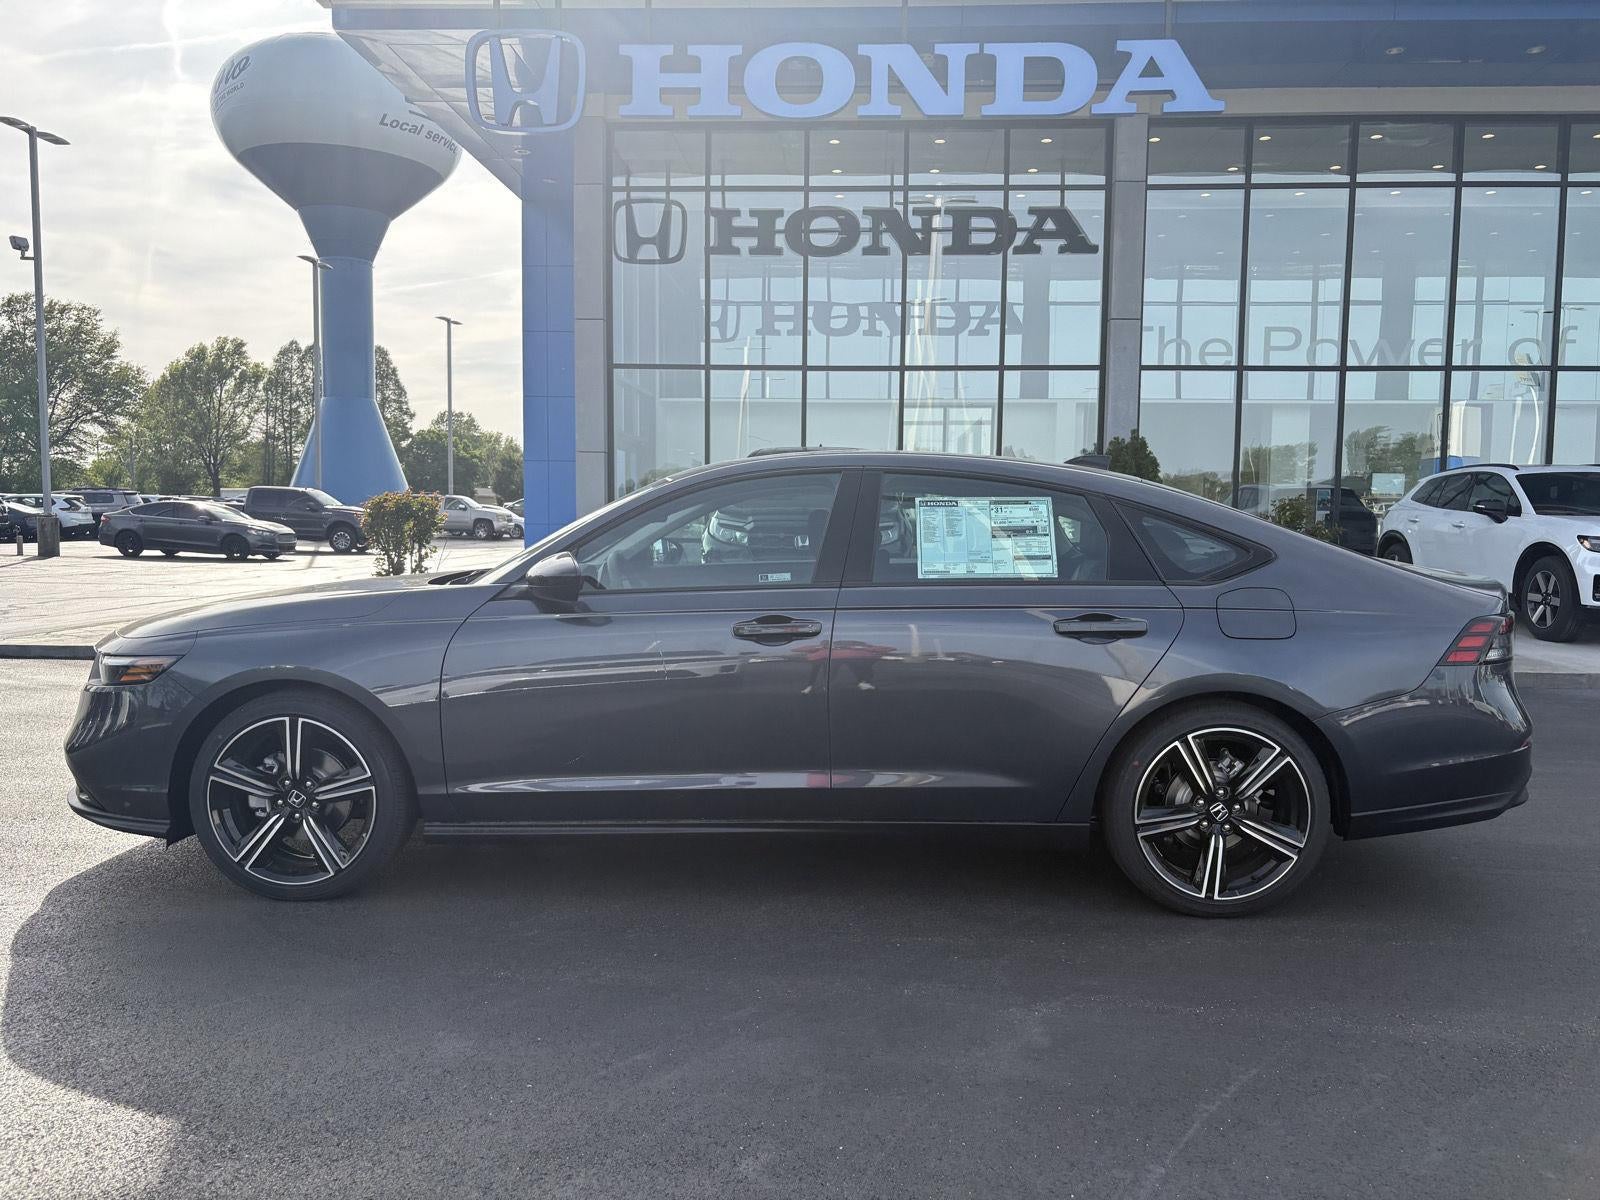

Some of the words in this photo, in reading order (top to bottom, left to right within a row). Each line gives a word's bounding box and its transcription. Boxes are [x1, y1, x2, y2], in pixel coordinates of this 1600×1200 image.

[618, 39, 1225, 118] HONDA
[379, 113, 424, 136] Local
[709, 205, 1099, 257] HONDA
[1262, 326, 1483, 366] Power
[1507, 325, 1578, 366] of
